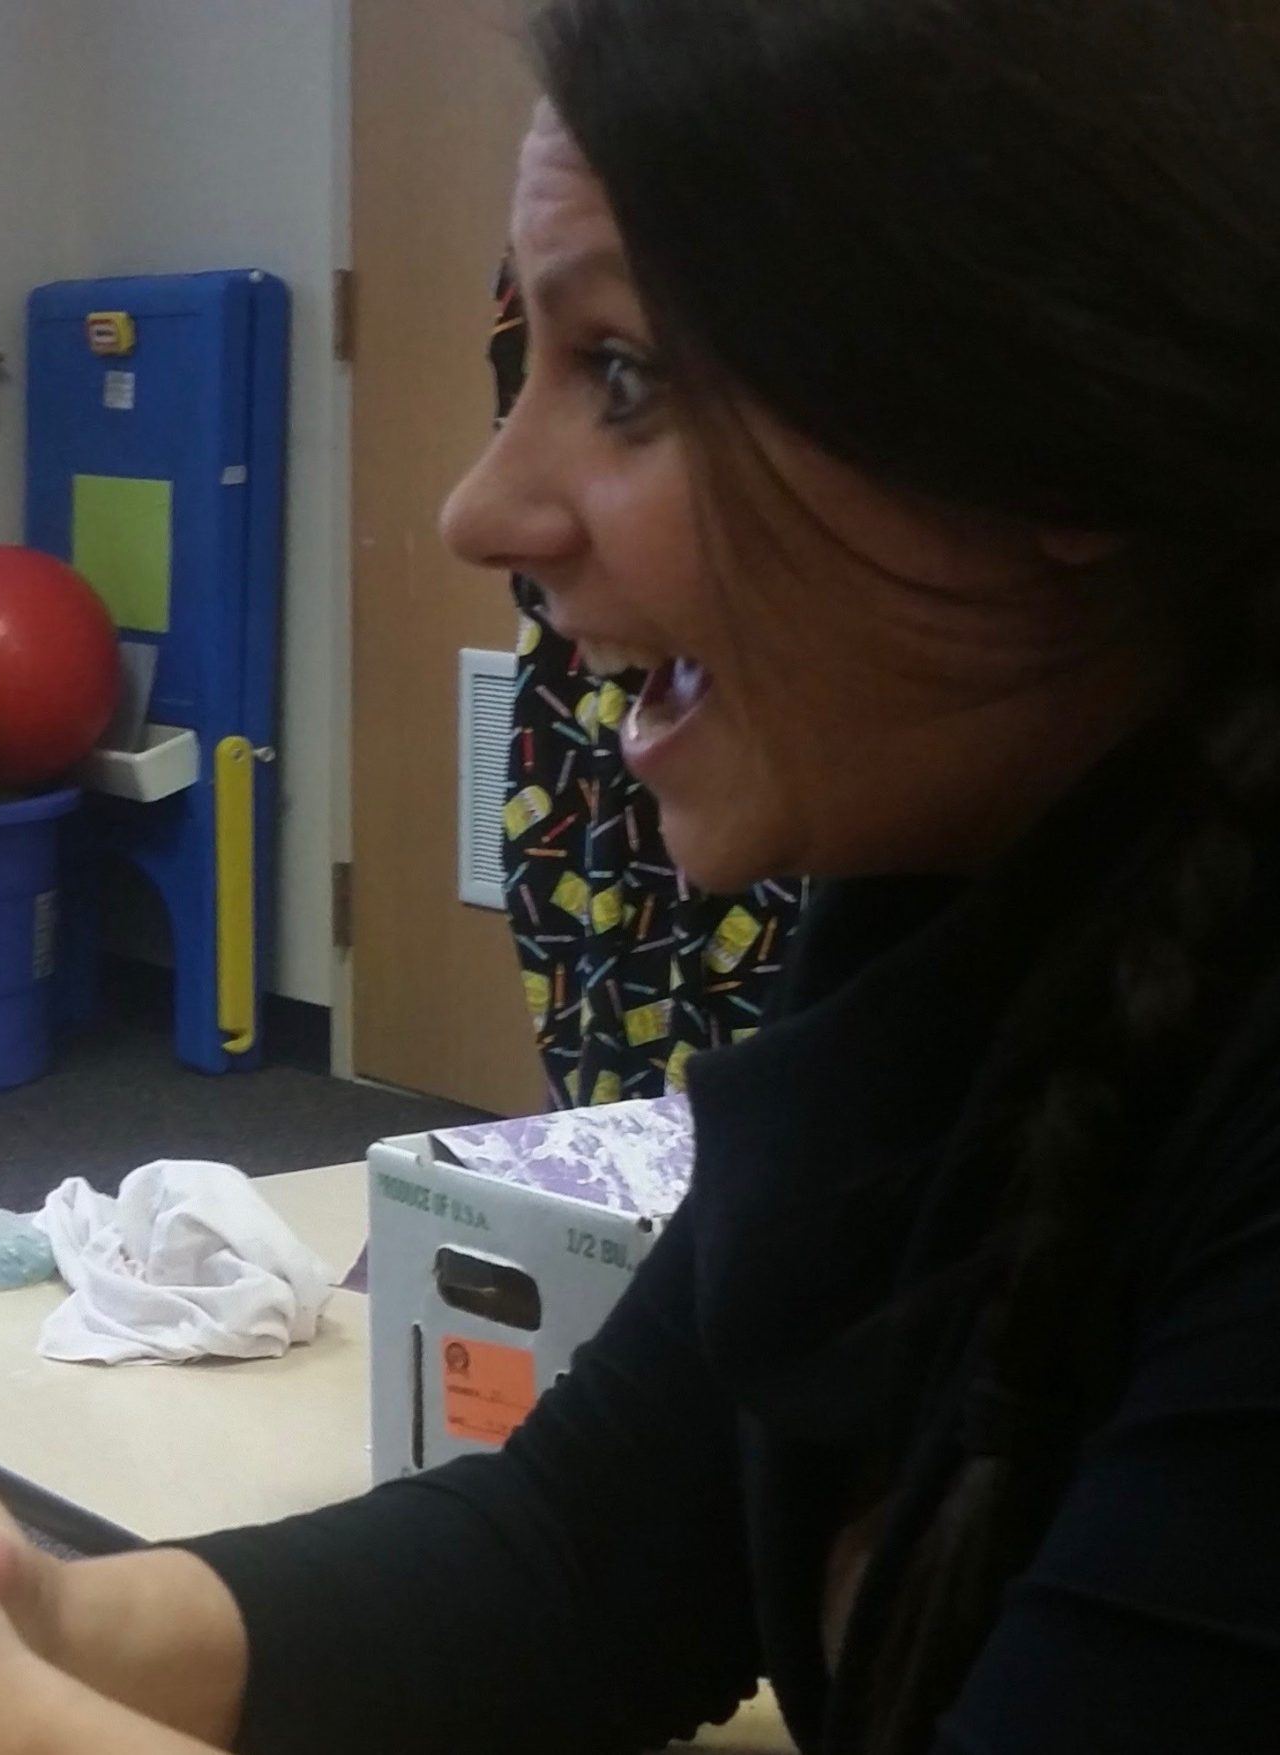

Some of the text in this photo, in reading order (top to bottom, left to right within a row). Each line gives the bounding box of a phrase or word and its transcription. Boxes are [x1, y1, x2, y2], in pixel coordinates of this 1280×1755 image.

[377, 1171, 431, 1213] PRODUCE
[432, 1192, 448, 1217] OF
[566, 1228, 596, 1259] 1/2
